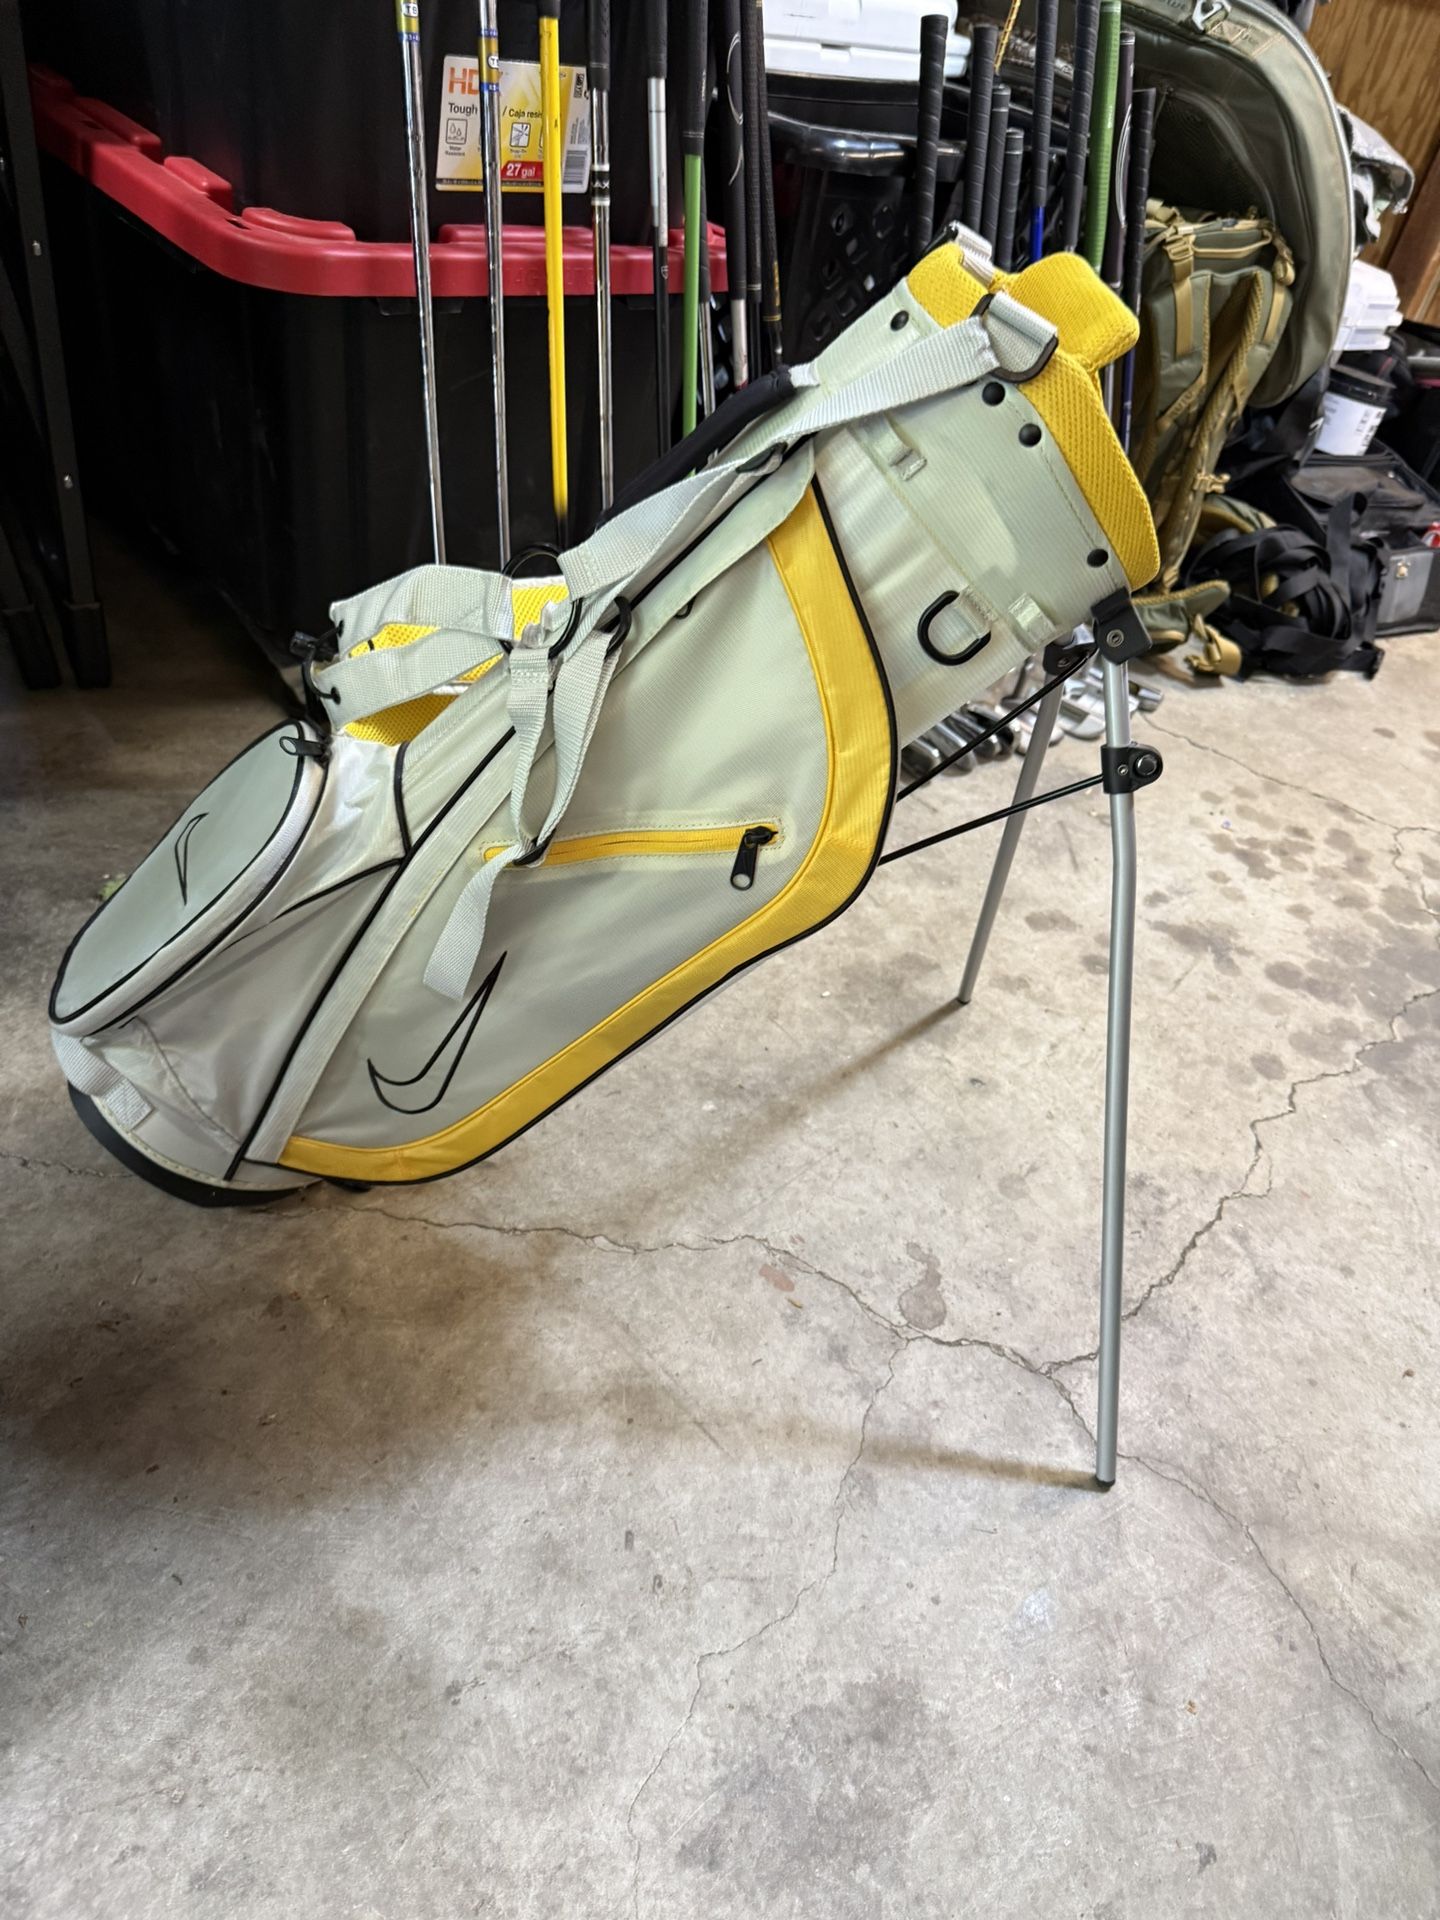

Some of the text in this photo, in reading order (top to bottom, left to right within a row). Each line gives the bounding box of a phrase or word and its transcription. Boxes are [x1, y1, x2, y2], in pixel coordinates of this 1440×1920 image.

[448, 102, 478, 116] Tough
[509, 109, 525, 120] Caja
[506, 162, 536, 178] 27 gal
